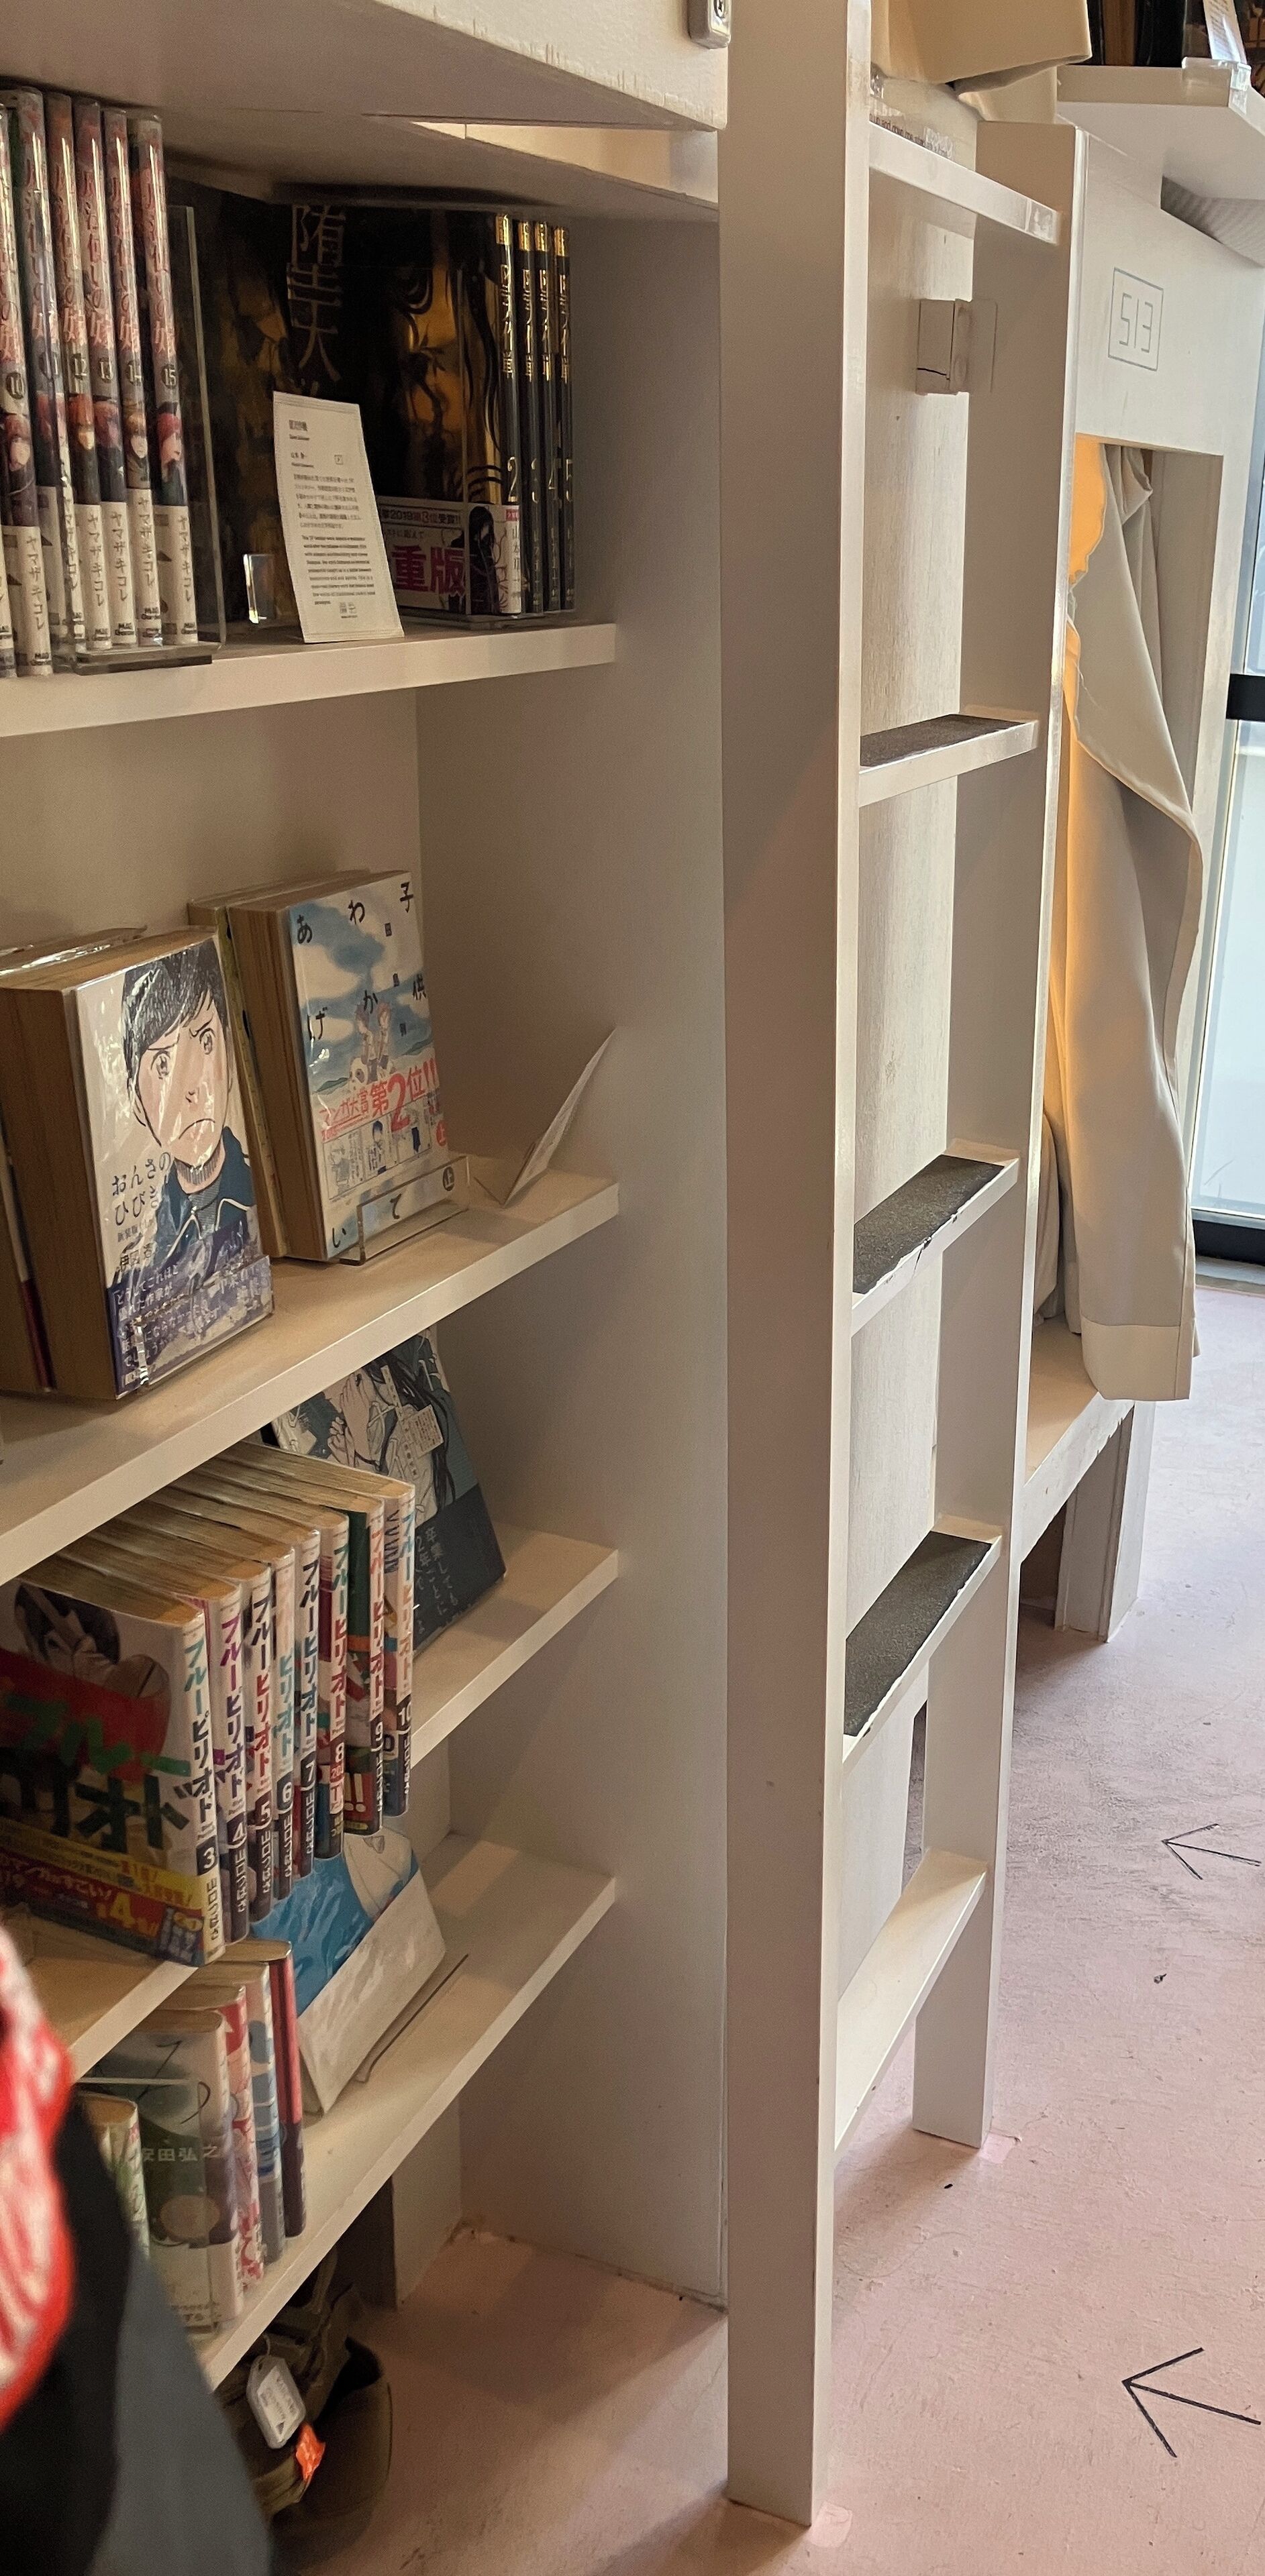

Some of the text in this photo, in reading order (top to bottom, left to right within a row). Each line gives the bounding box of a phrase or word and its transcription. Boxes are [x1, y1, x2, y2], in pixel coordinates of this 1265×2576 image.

[1119, 292, 1153, 353] 513
[9, 376, 24, 395] 10
[164, 368, 176, 386] 15
[507, 457, 517, 502] 2
[111, 511, 128, 602] ヤマザキコレ
[391, 544, 466, 596] 重版
[26, 535, 45, 631] ヤマザキコレ
[111, 1151, 172, 1197] おんさの
[115, 1185, 160, 1226] ひびき
[398, 1701, 412, 1727] 10
[375, 1721, 383, 1741] 9
[336, 1741, 344, 1764] 8
[305, 1760, 315, 1782] 7
[282, 1781, 293, 1803] 6
[260, 1801, 271, 1822] 5
[232, 1822, 244, 1843] 4
[204, 1847, 215, 1869] 3
[142, 2145, 221, 2163] 安田弘之
